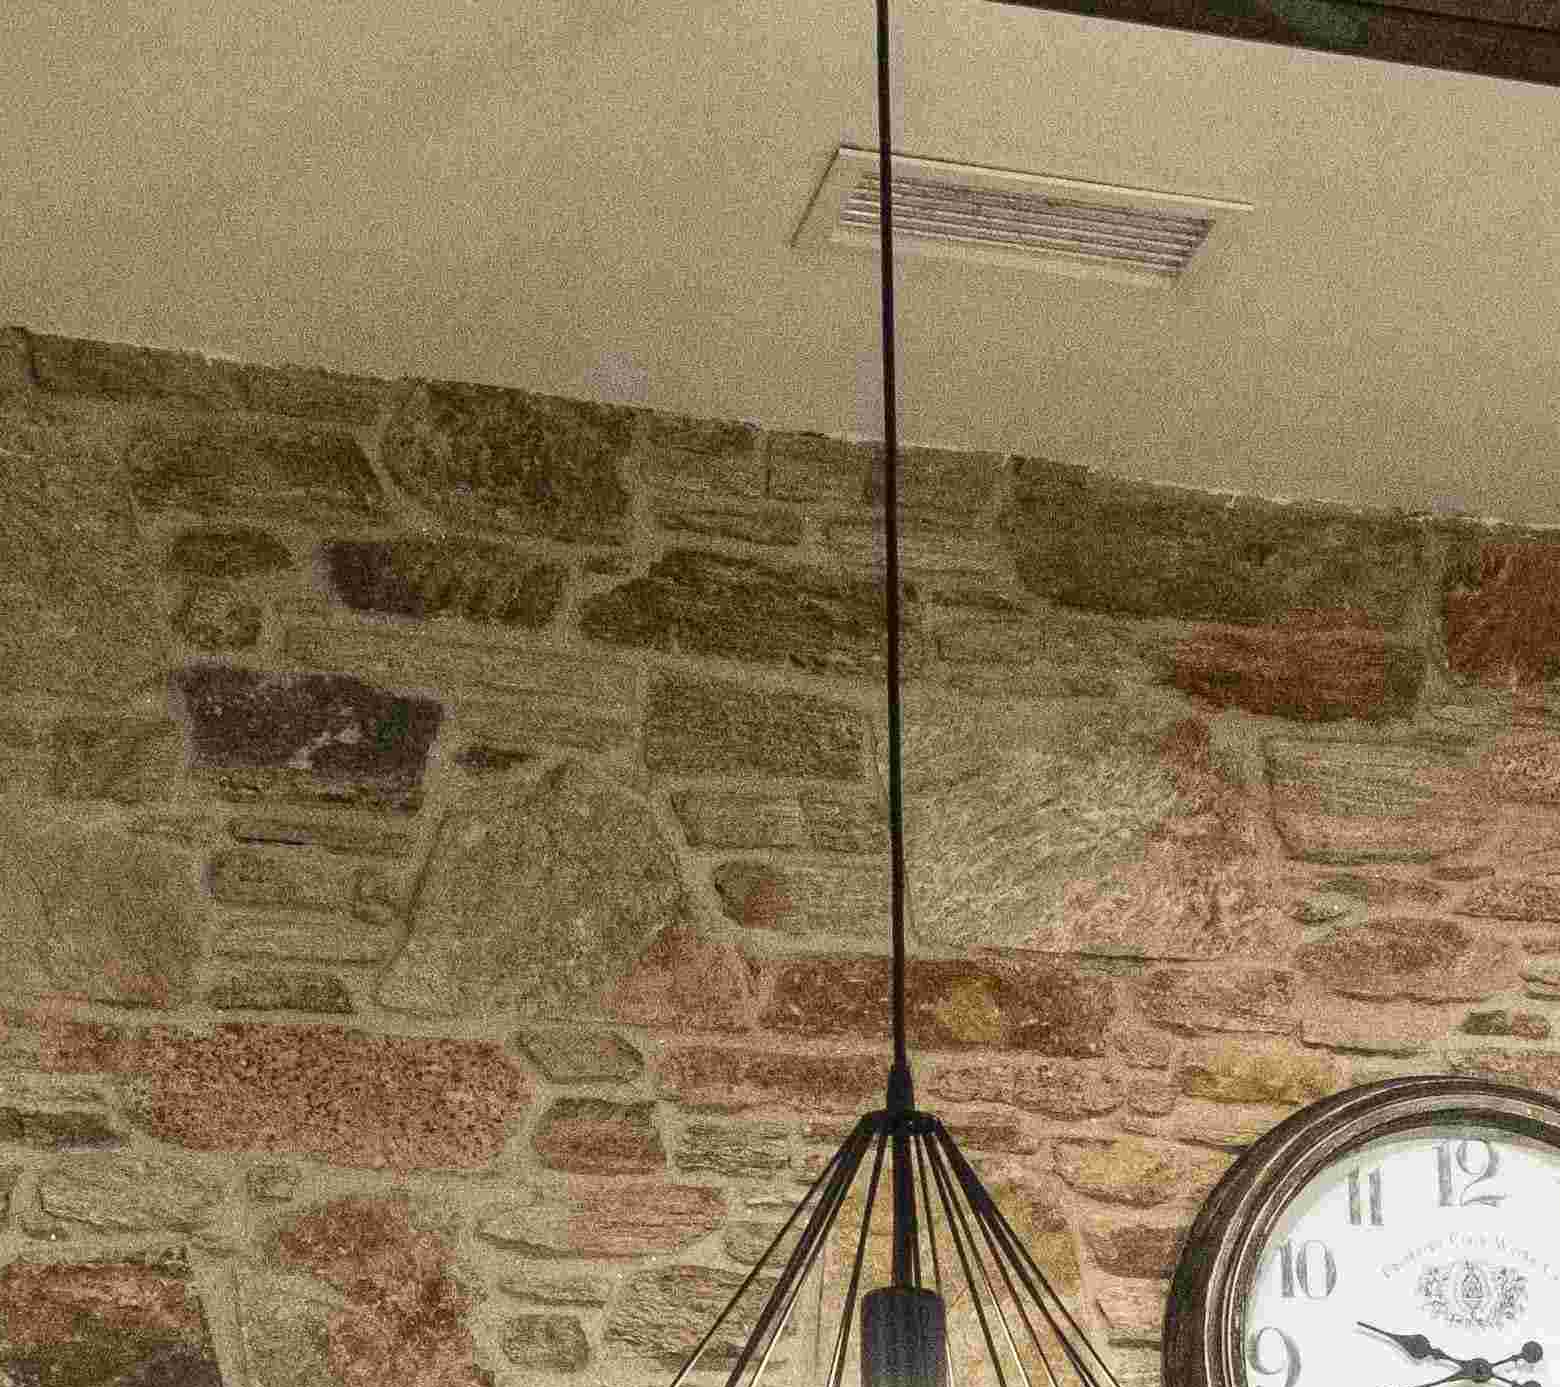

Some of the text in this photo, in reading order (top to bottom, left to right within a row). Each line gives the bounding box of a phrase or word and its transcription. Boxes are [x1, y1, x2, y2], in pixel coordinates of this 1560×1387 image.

[1345, 1166, 1384, 1227] 11
[1436, 1137, 1506, 1208] 12
[1276, 1238, 1338, 1300] 10
